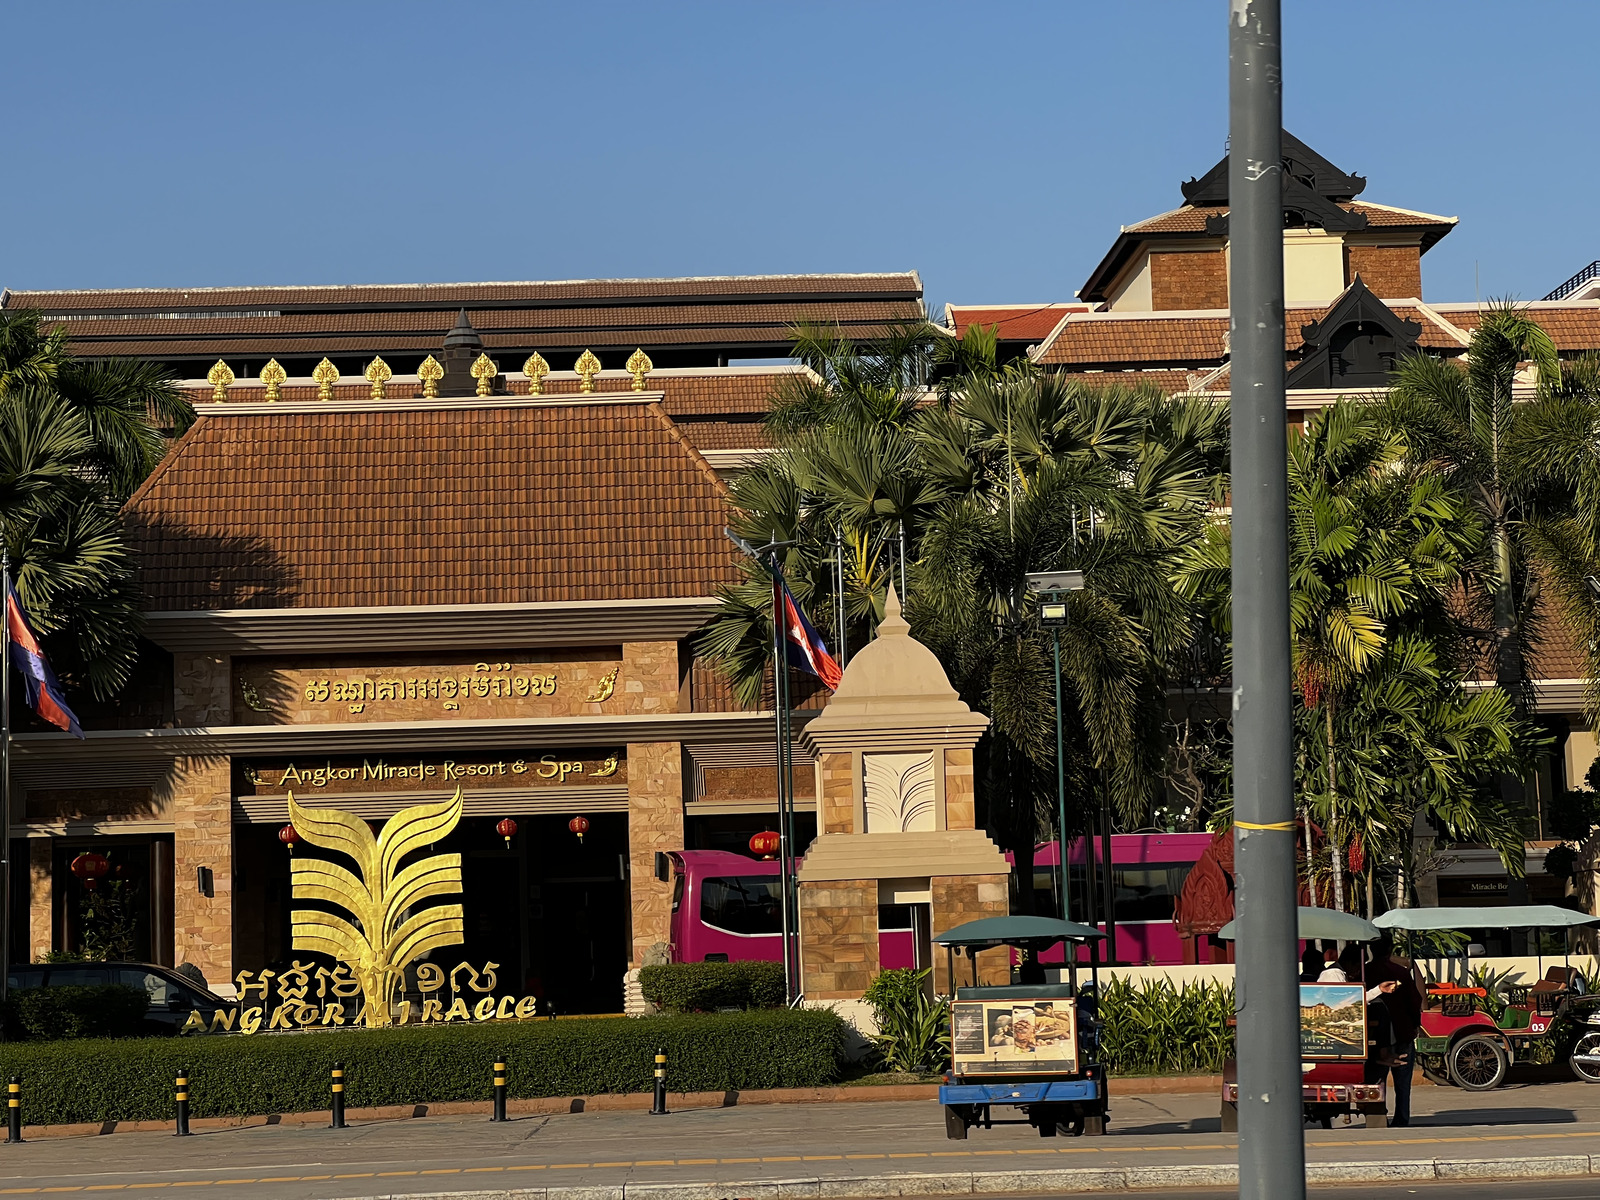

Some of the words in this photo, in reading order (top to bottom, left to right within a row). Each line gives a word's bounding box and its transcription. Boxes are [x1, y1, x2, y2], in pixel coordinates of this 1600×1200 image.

[279, 760, 359, 787] Angkor
[363, 758, 436, 781] Miracle
[444, 759, 507, 781] Resort
[511, 759, 528, 774] &
[537, 754, 584, 782] Spa
[180, 1002, 345, 1035] ANGKOR
[353, 996, 537, 1027] MIRACLE
[1531, 1023, 1545, 1032] 03
